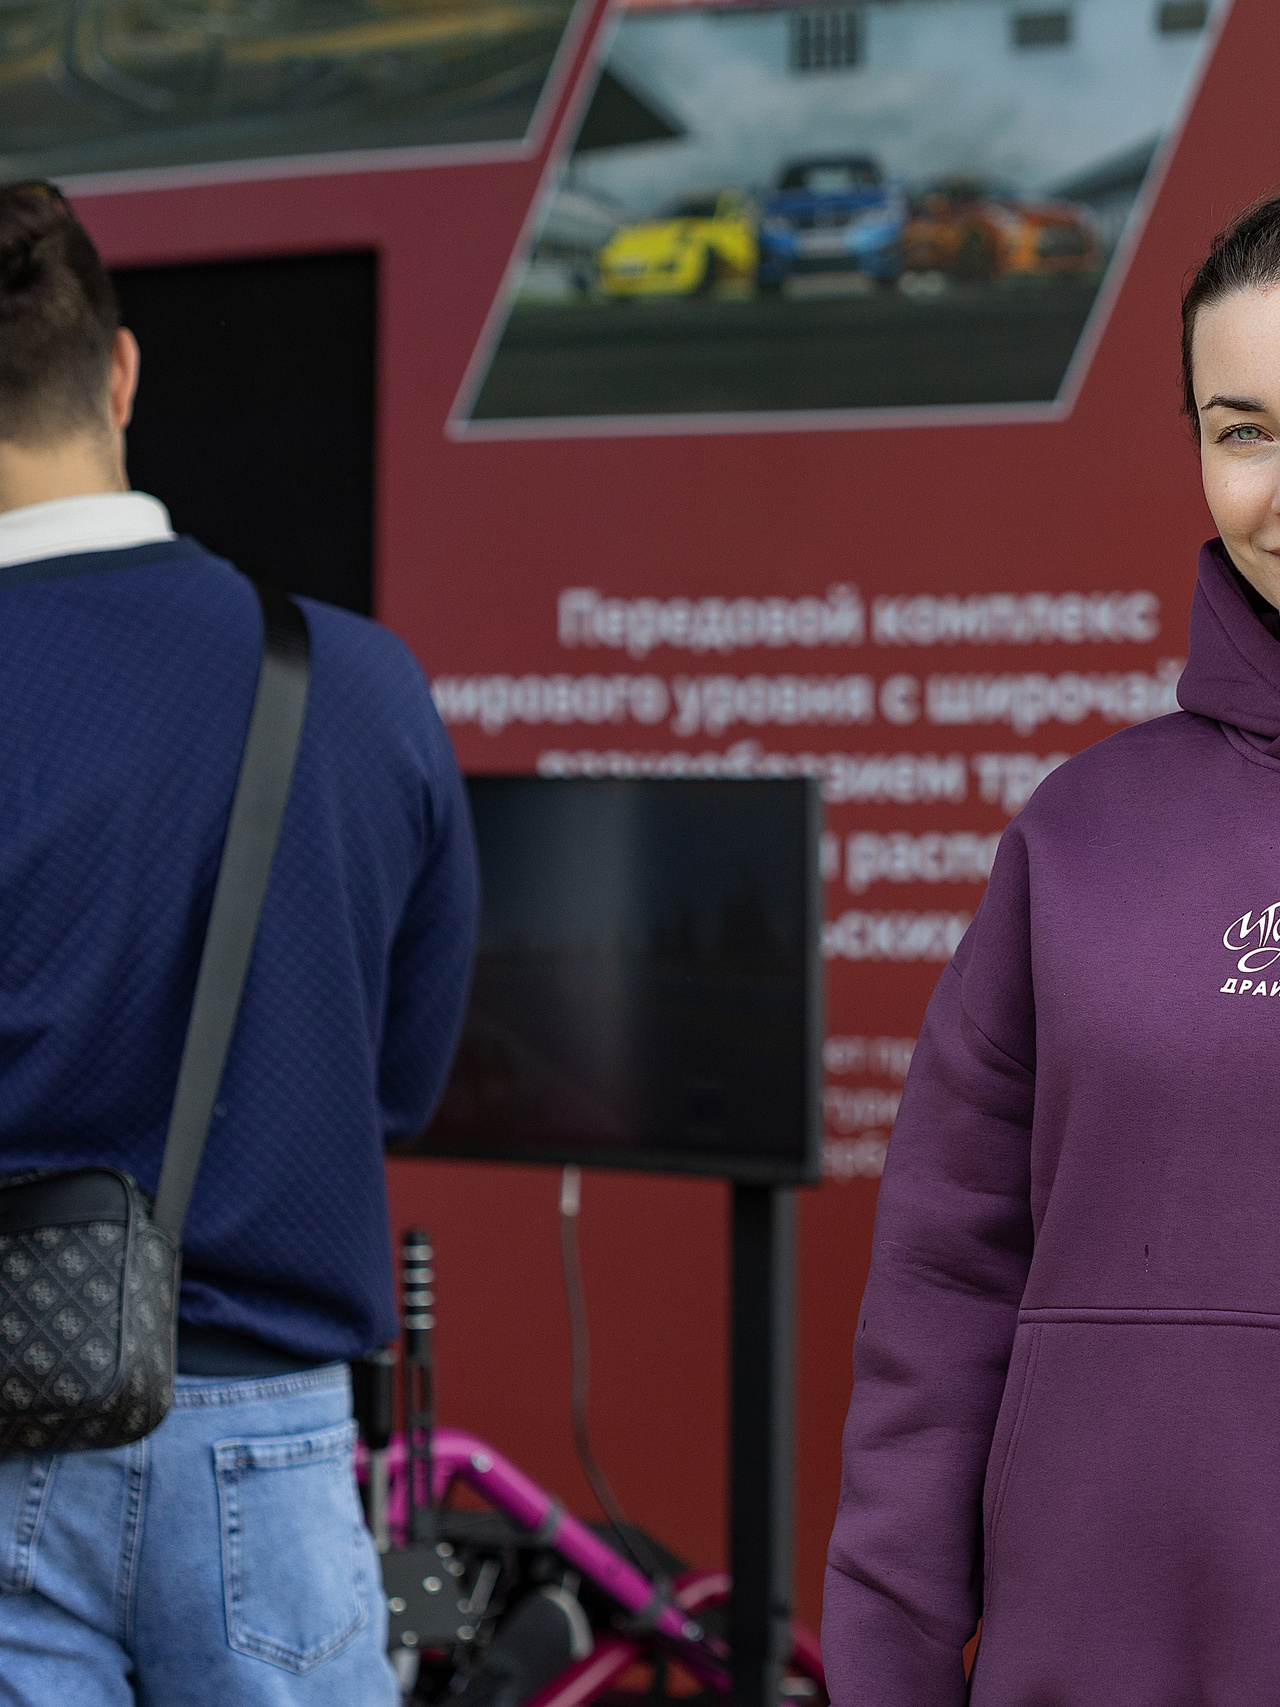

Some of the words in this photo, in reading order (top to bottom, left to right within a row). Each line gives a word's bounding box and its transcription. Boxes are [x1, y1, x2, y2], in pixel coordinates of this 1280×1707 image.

[558, 585, 863, 657] Передовой
[872, 591, 1158, 643] комплекс
[672, 674, 874, 735] уровня
[879, 674, 922, 723] с
